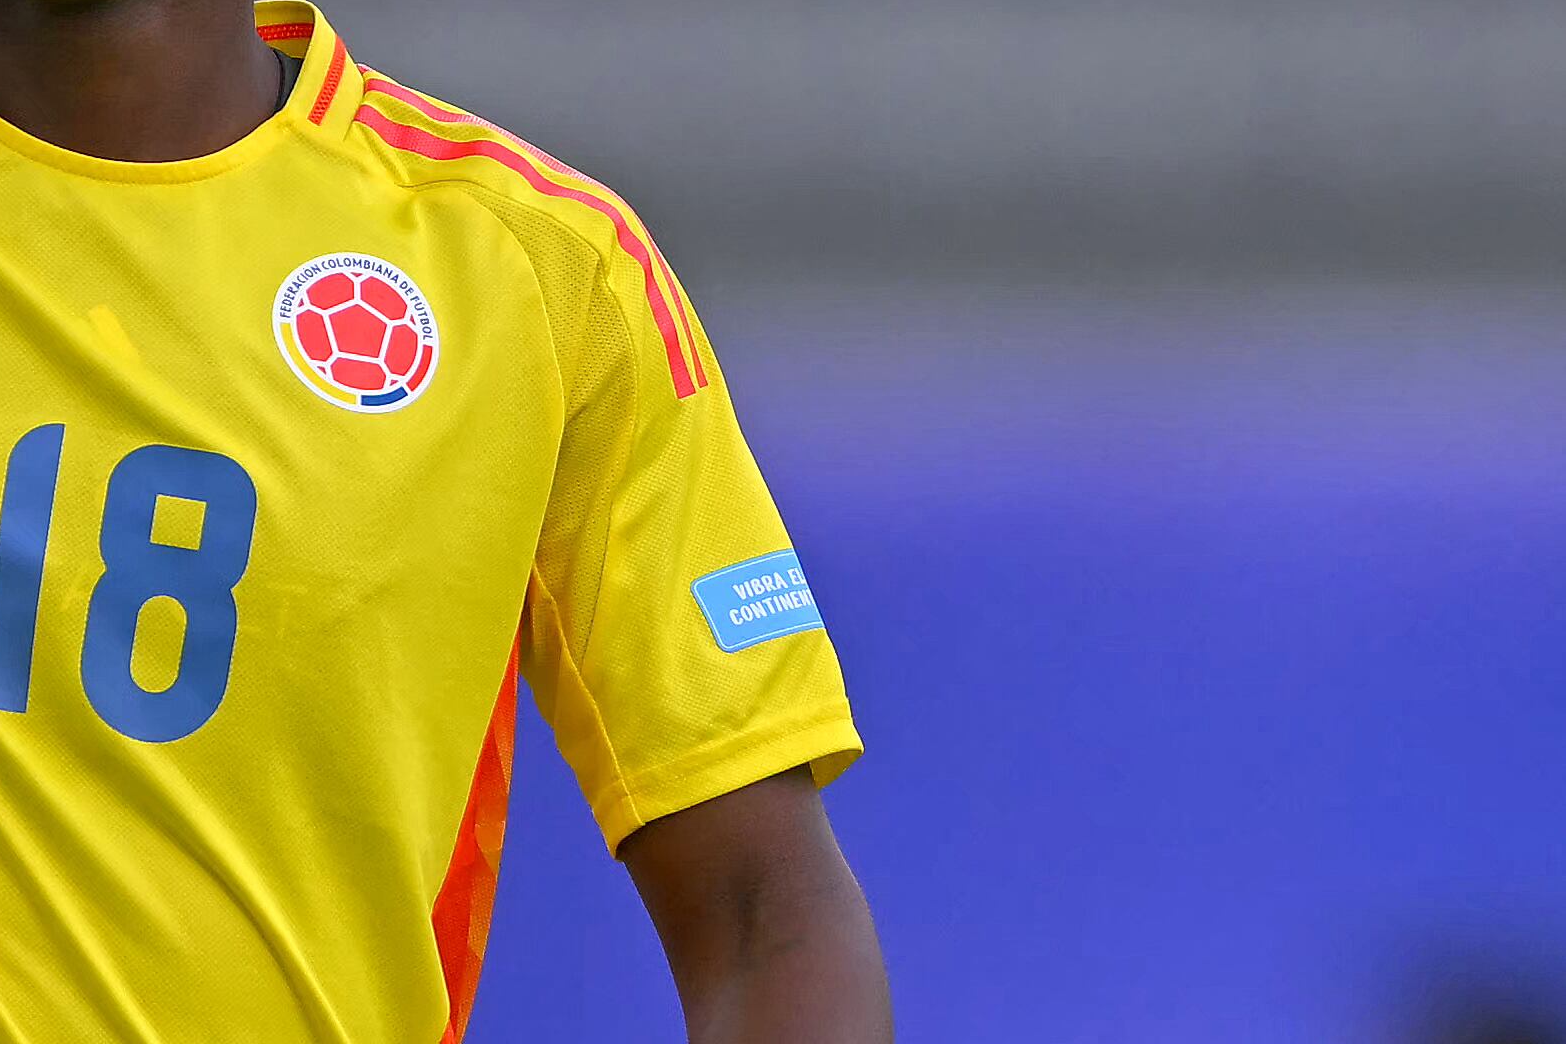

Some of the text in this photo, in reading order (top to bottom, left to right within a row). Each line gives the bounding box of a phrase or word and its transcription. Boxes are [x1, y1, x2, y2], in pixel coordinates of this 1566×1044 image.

[321, 257, 400, 284] COLOMBIANA
[399, 280, 414, 296] DE
[410, 295, 433, 340] FÚTBOL
[732, 572, 788, 600] VIBRA
